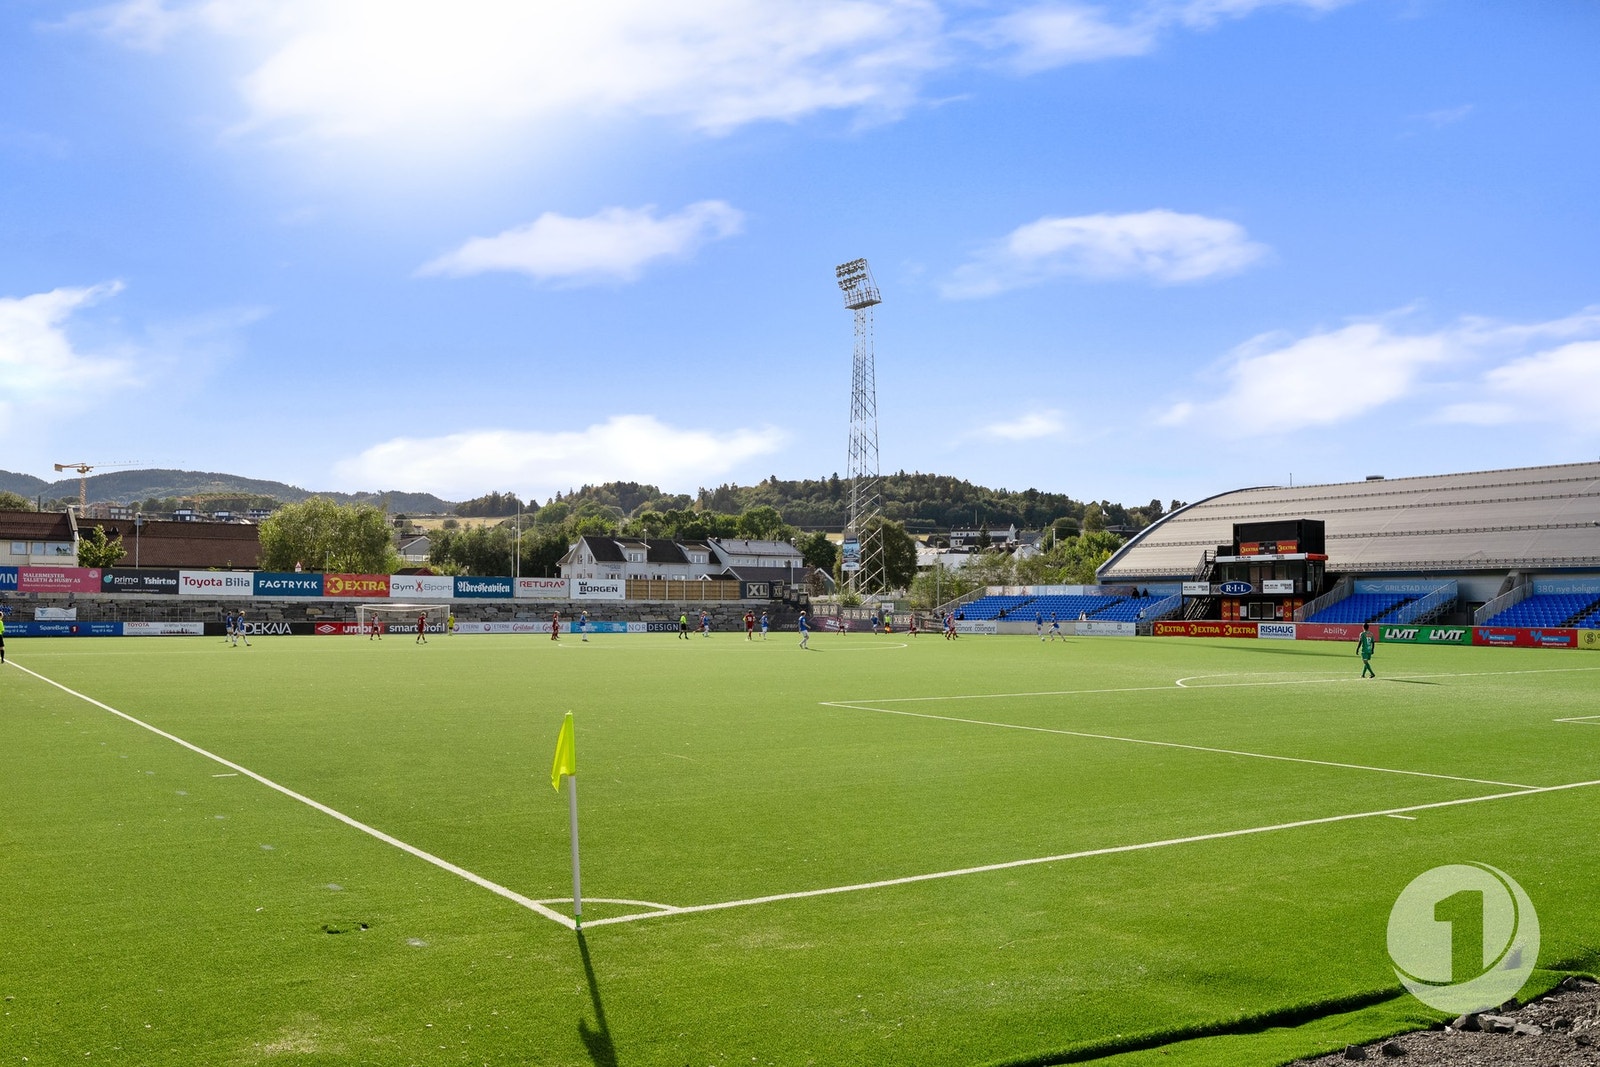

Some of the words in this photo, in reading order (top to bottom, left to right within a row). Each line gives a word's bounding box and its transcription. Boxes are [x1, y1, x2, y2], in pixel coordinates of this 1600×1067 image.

[114, 576, 138, 584] prima
[182, 576, 222, 588] Toyota
[226, 578, 250, 586] Bilia
[259, 580, 318, 588] FAGTRYKK
[345, 581, 386, 590] EXTRA
[749, 584, 767, 596] XL
[1260, 626, 1294, 634] RISHAUG
[1324, 628, 1348, 636] Ability
